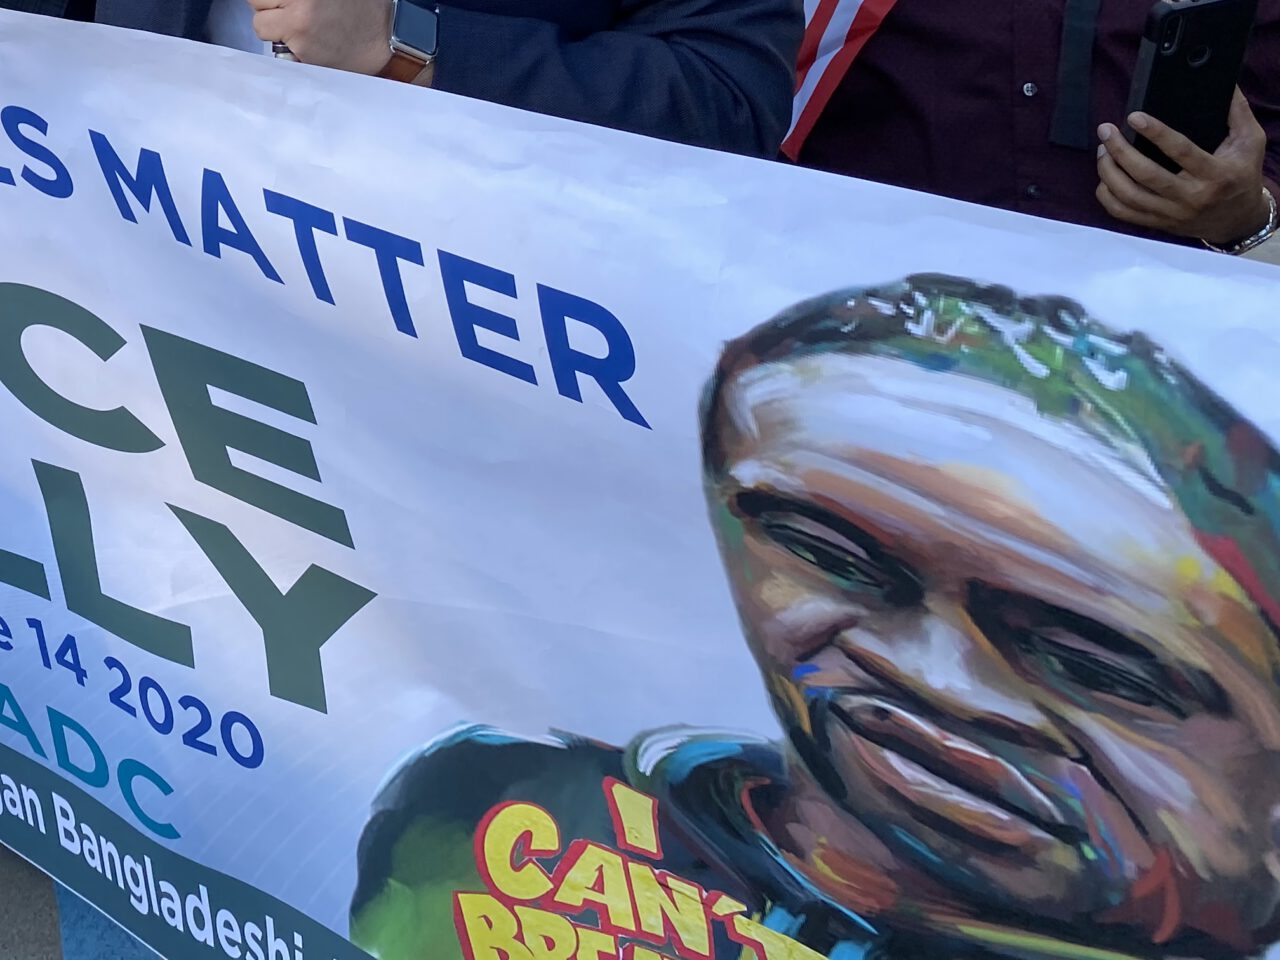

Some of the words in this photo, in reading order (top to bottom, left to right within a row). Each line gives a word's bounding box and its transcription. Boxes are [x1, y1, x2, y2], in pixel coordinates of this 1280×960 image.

[87, 128, 653, 431] MATTER
[26, 617, 88, 688] 14
[103, 655, 264, 770] 2020
[51, 790, 305, 960] Bangladeshi
[604, 777, 662, 860] I
